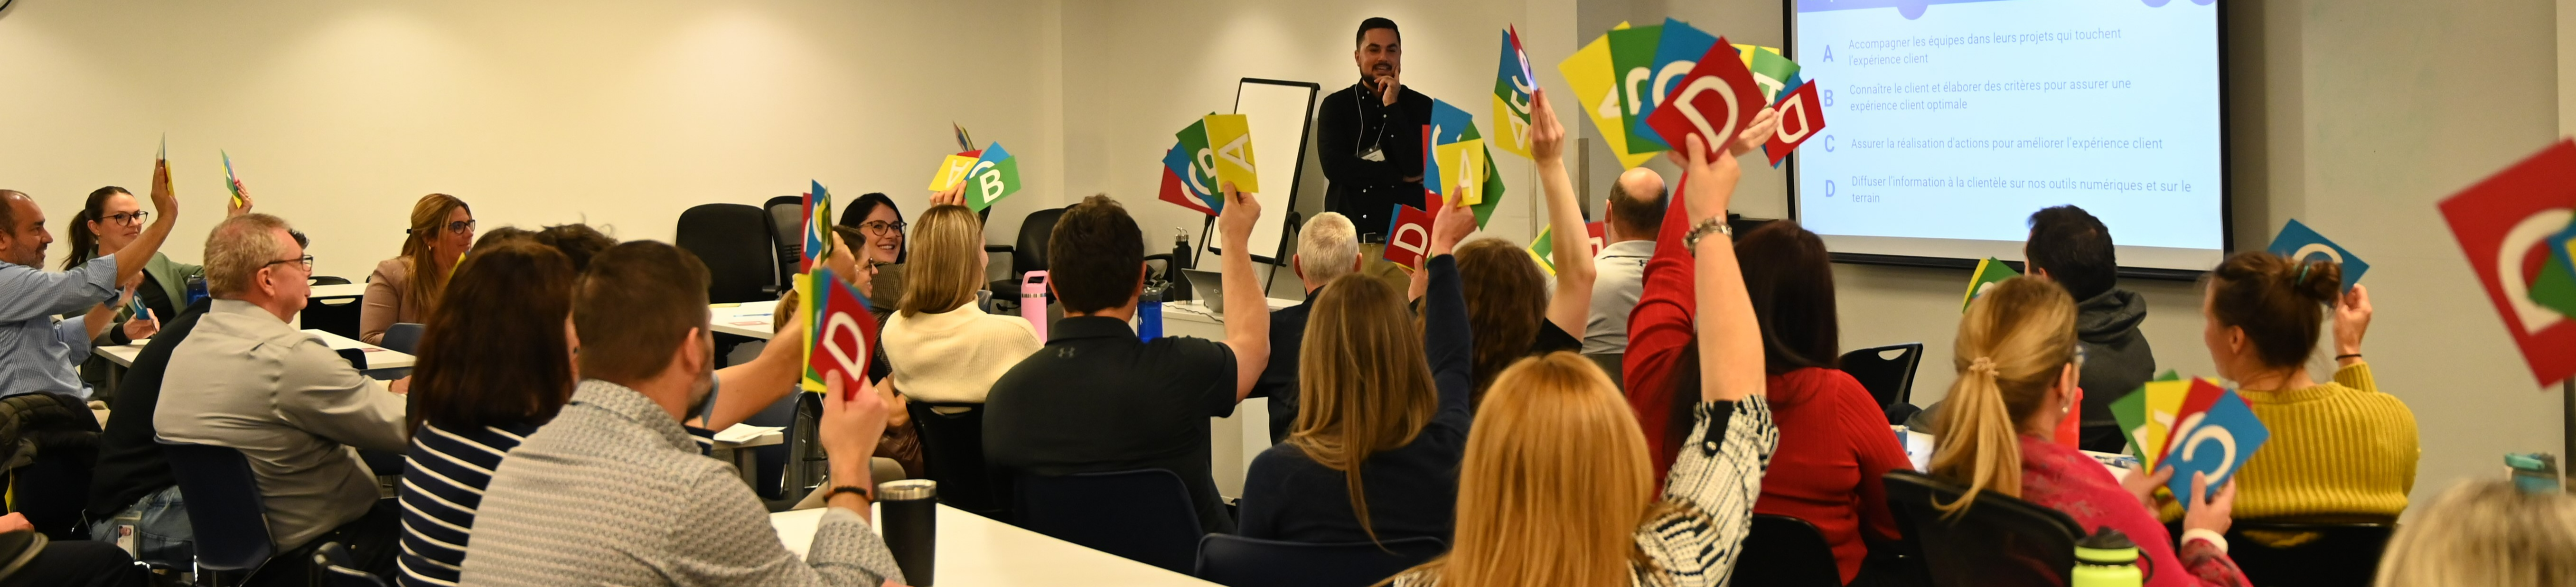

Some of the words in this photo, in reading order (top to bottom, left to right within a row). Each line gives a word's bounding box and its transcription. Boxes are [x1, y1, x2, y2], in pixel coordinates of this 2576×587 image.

[1848, 39, 1911, 51] Accompagner
[1913, 36, 1926, 47] les
[1929, 35, 1965, 49] équipes
[1967, 33, 1990, 45] dans
[1993, 32, 2017, 44] leurs
[2020, 31, 2054, 46] projets
[2057, 29, 2072, 44] qui
[2075, 27, 2121, 40] touchent
[1822, 44, 1834, 63] A
[1849, 55, 1901, 68] l'expérience
[1903, 53, 1928, 64] client
[1850, 83, 1892, 95] Connaître
[1894, 83, 1902, 93] le
[1904, 82, 1929, 93] client
[1932, 83, 1940, 93] et
[1943, 81, 1982, 93] élaborer
[1984, 80, 2001, 92] des
[2004, 79, 2041, 91] critères
[2044, 81, 2067, 93] pour
[2070, 80, 2109, 90] assurer
[2112, 80, 2131, 89] une
[1824, 89, 1834, 107] B
[1850, 100, 1897, 113] expérience
[1900, 99, 1924, 110] client
[1927, 98, 1967, 112] optimale
[1673, 75, 1739, 154] D
[1777, 93, 1810, 144] D
[1218, 132, 1255, 174] A
[1824, 134, 1835, 153] C
[1851, 139, 1884, 149] Assurer
[1887, 137, 1894, 149] la
[1897, 137, 1945, 149] réalisation
[1947, 137, 1989, 149] d'actions
[1992, 140, 2014, 151] pour
[2017, 137, 2064, 149] améliorer
[2067, 136, 2129, 151] l'expérience
[2132, 137, 2163, 149] client
[945, 158, 971, 189] A
[1458, 148, 1474, 198] A
[979, 169, 1004, 204] B
[1825, 179, 1836, 198] D
[1852, 175, 1886, 187] Diffuser
[1888, 175, 1945, 187] l'information
[1948, 176, 1953, 187] à
[1956, 176, 1964, 187] la
[1967, 176, 2007, 188] clientèle
[2010, 180, 2025, 188] sur
[2028, 180, 2046, 189] nos
[2049, 177, 2077, 189] outils
[2080, 178, 2143, 194] numériques
[2146, 181, 2157, 191] et
[2160, 183, 2178, 192] sur
[2182, 179, 2192, 192] le
[1852, 193, 1880, 203] terrain
[1393, 222, 1428, 256] D
[823, 311, 867, 382] D
[2182, 424, 2237, 487] C
